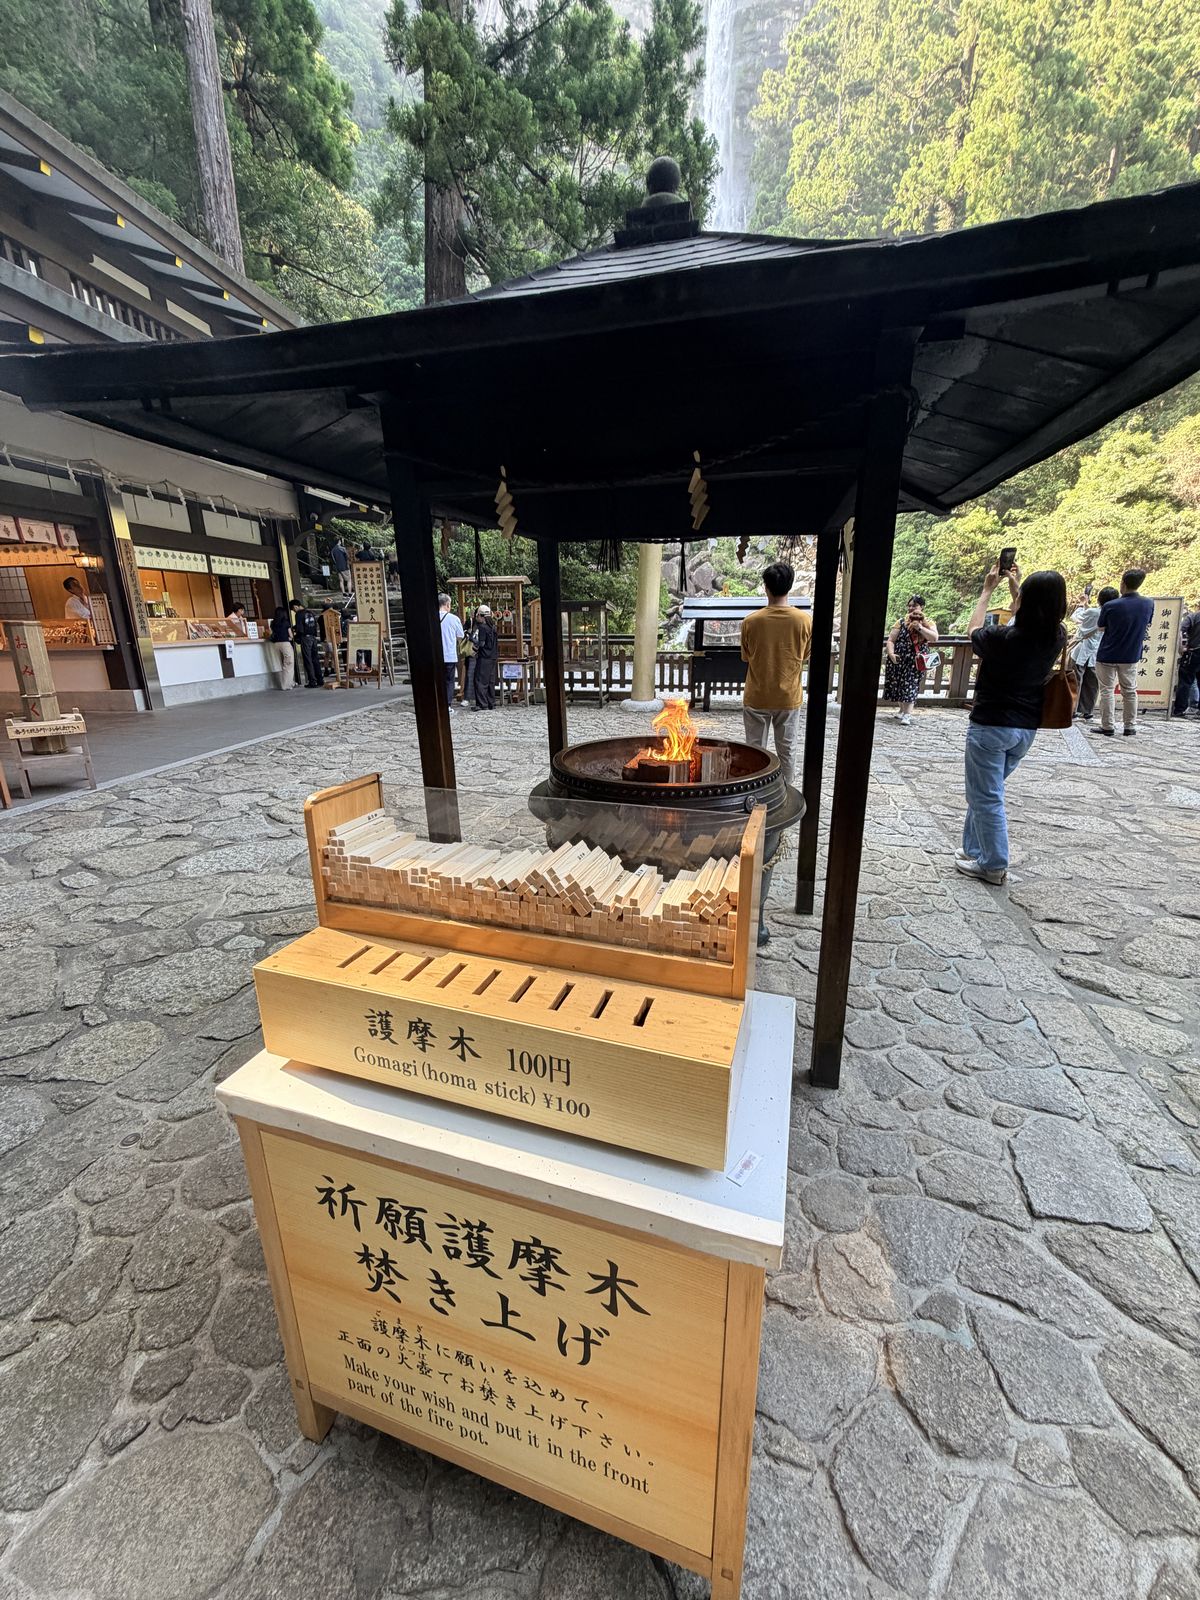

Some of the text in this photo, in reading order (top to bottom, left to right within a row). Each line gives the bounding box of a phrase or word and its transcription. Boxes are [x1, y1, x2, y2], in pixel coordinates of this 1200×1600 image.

[364, 1008, 571, 1087] 護摩木 100円
[484, 1080, 536, 1107] stick)
[315, 1174, 652, 1317] 祈願護摩木
[354, 1243, 611, 1367] 焚き上げ
[343, 1353, 650, 1495] Make your wish and put it in the front
[347, 1378, 489, 1446] part of the fire pot.
